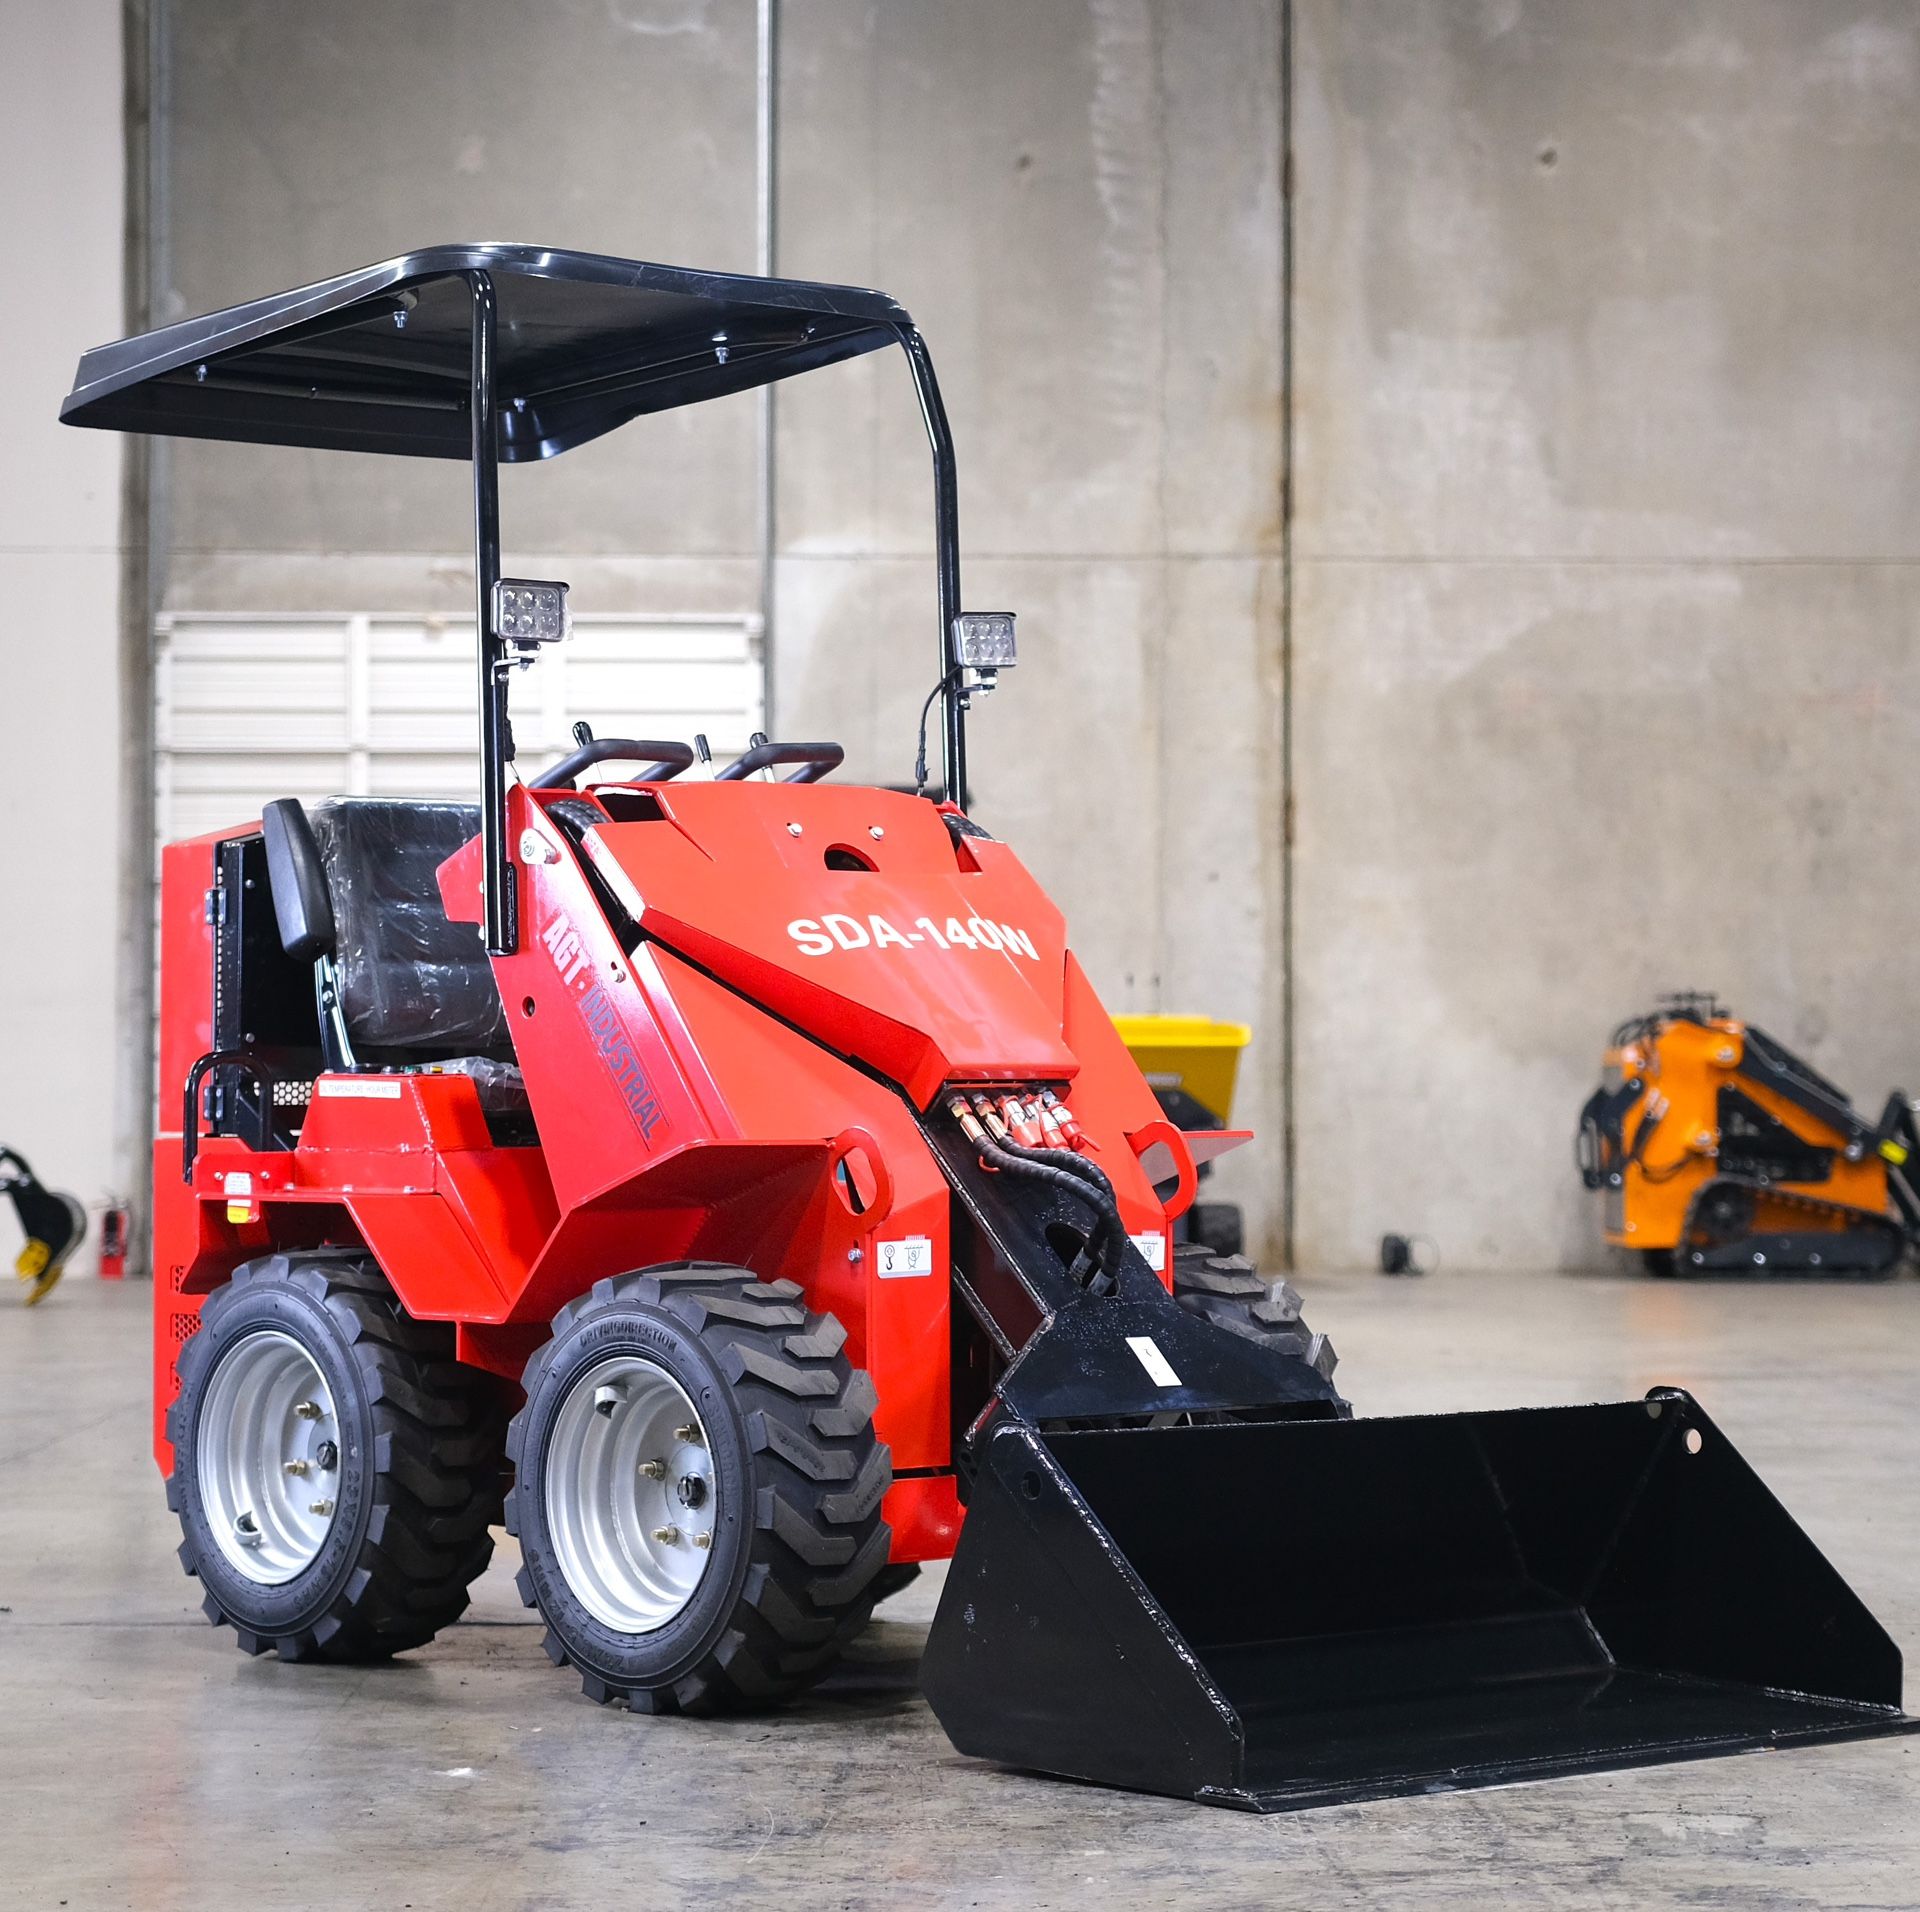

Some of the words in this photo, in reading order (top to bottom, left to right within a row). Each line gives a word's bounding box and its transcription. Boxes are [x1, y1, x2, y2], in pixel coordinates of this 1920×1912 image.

[787, 913, 1041, 961] SDA-140W
[542, 912, 591, 986] AGT
[580, 985, 663, 1140] INDUSTRIAL
